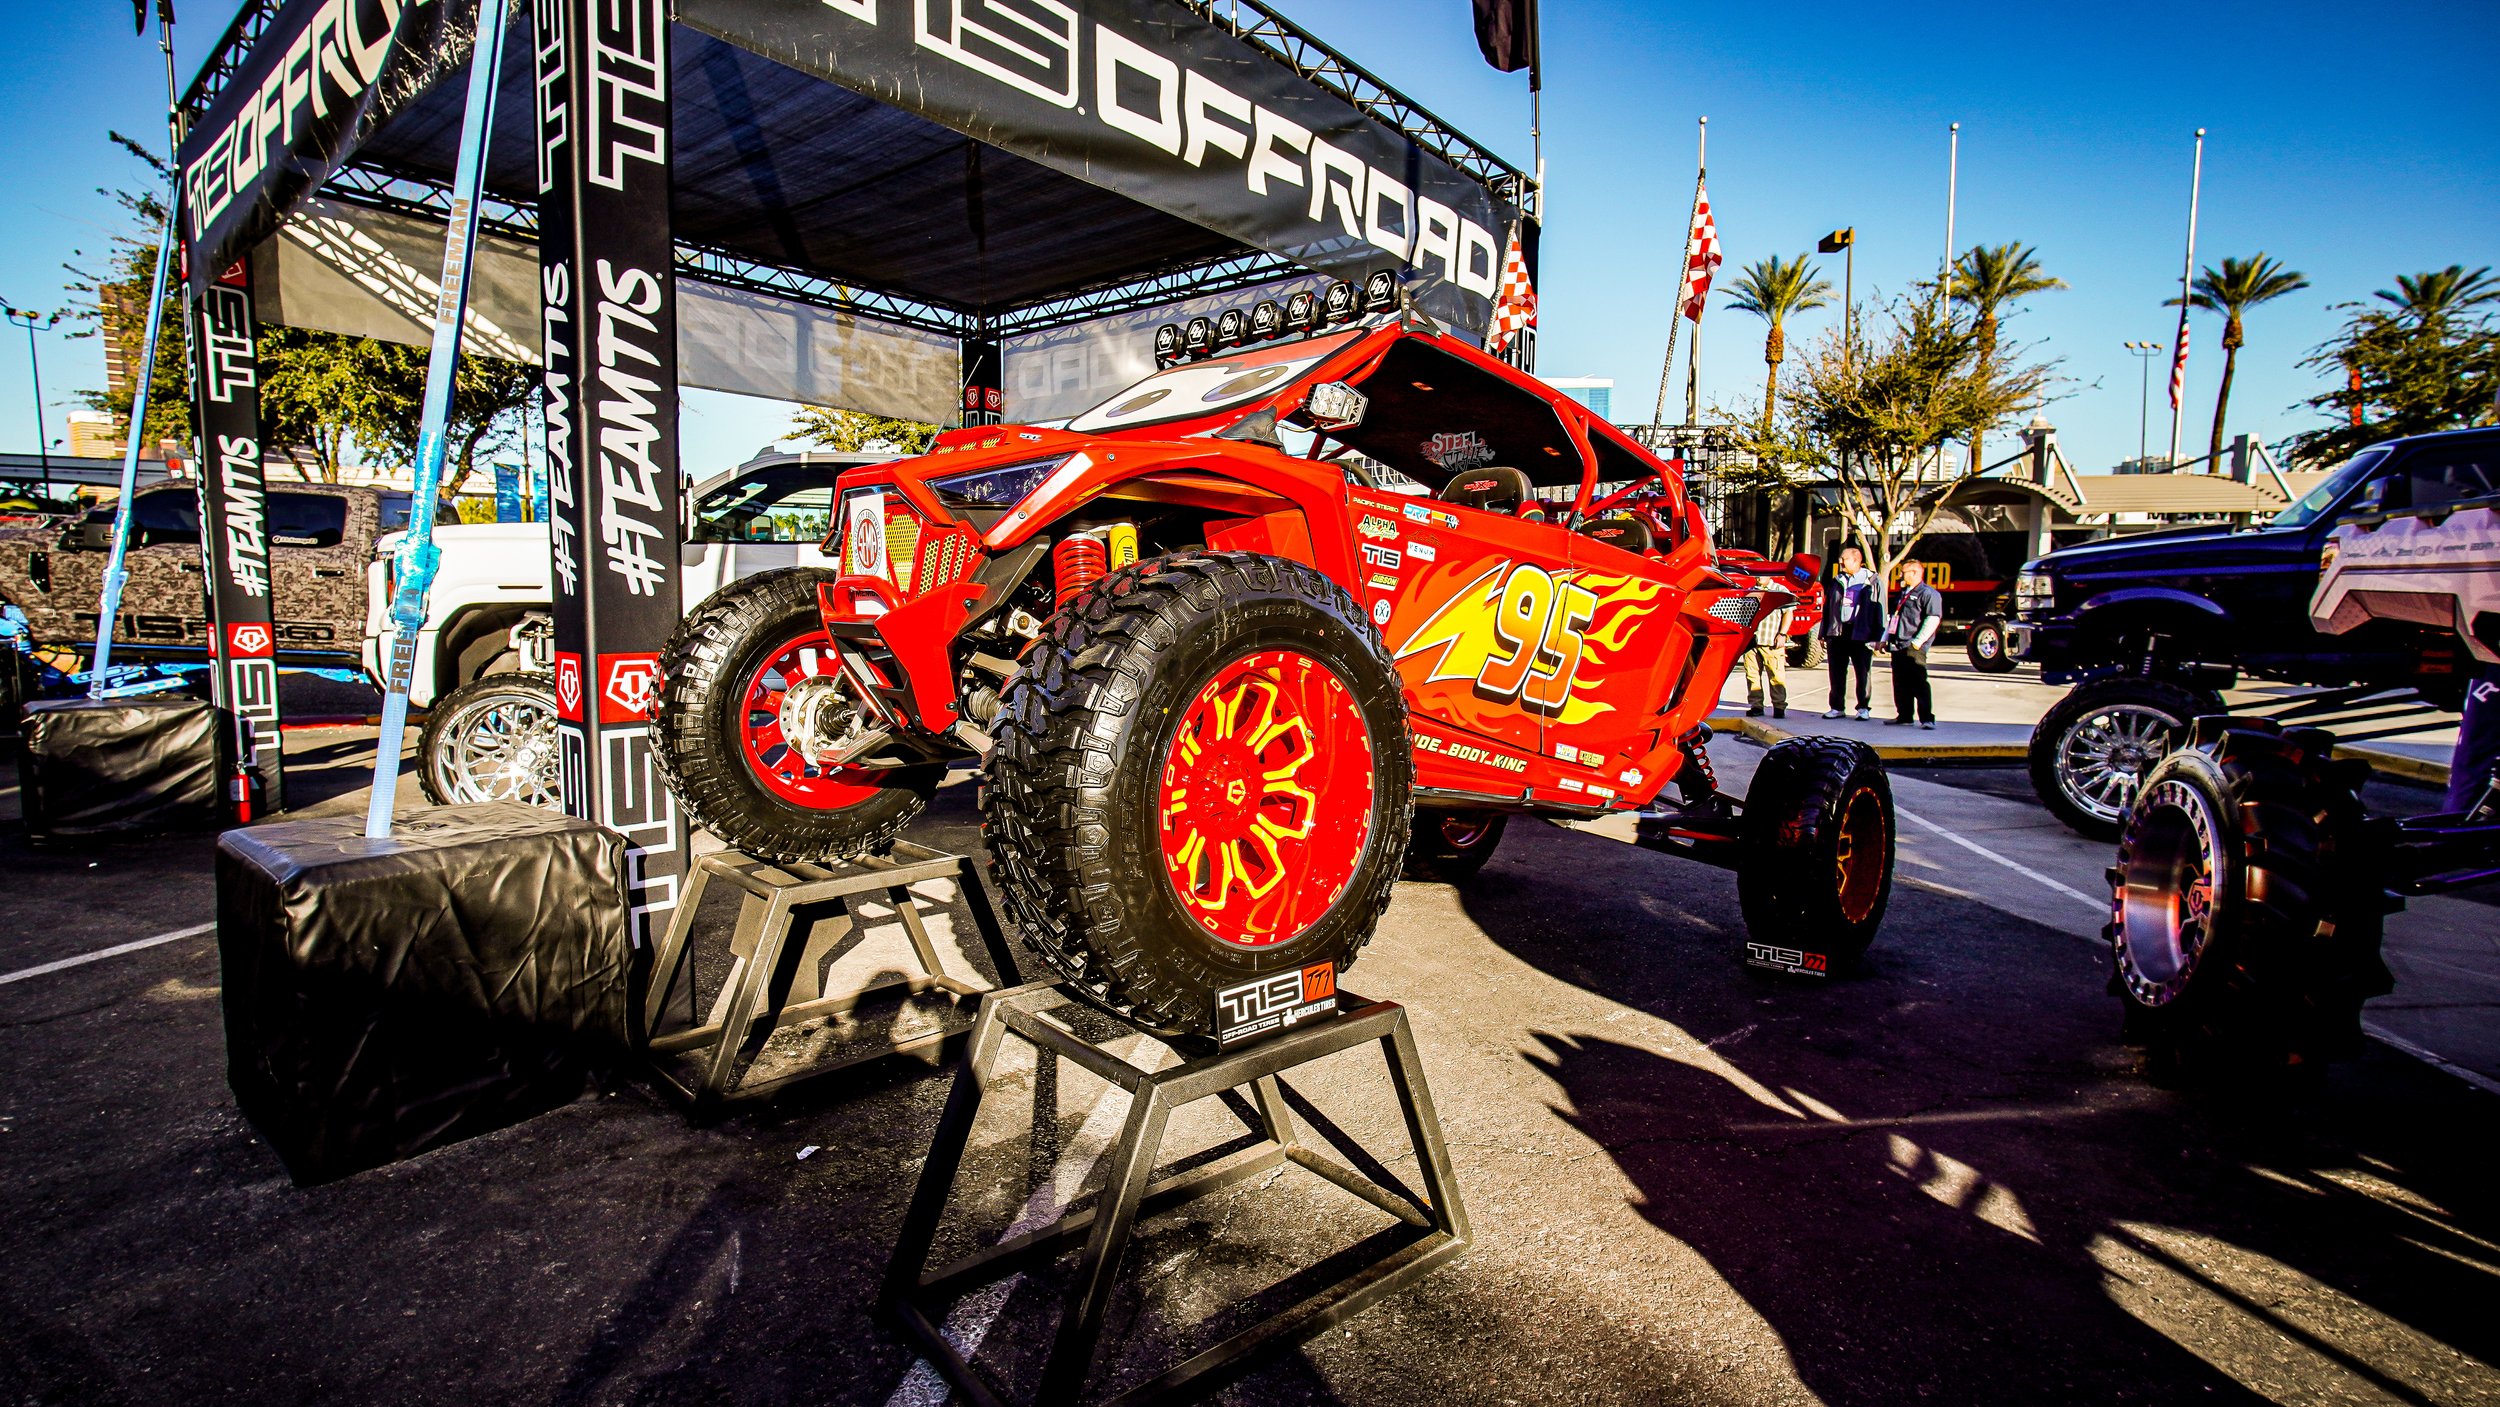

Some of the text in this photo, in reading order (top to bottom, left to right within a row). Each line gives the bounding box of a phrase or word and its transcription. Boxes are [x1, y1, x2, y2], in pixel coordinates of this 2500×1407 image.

[186, 119, 237, 242] TIS
[1096, 24, 1498, 300] OFFROAD
[440, 199, 469, 324] FREEMAN
[202, 285, 257, 402] TIS
[543, 262, 577, 596] #TEAMTIS
[597, 259, 666, 596] #TEAMTIS
[1431, 430, 1483, 453] STEEL
[217, 434, 270, 598] #TEAMTIS
[1353, 496, 1399, 513] PACIFIC STEREO
[1363, 515, 1396, 533] ALPHA
[1122, 545, 1135, 567] ZOIL
[1363, 545, 1399, 567] TIS
[1372, 574, 1398, 586] GIBSON
[1475, 562, 1599, 714] 95
[1242, 653, 1313, 669] TIS
[1327, 677, 1373, 905] OFFROAD
[1238, 922, 1309, 944] TIS
[1747, 941, 1803, 967] TIS
[1219, 969, 1304, 1023] TIS
[1293, 998, 1336, 1019] HERCULES TIRES
[1222, 1017, 1280, 1040] OFF-ROAD TIRES
